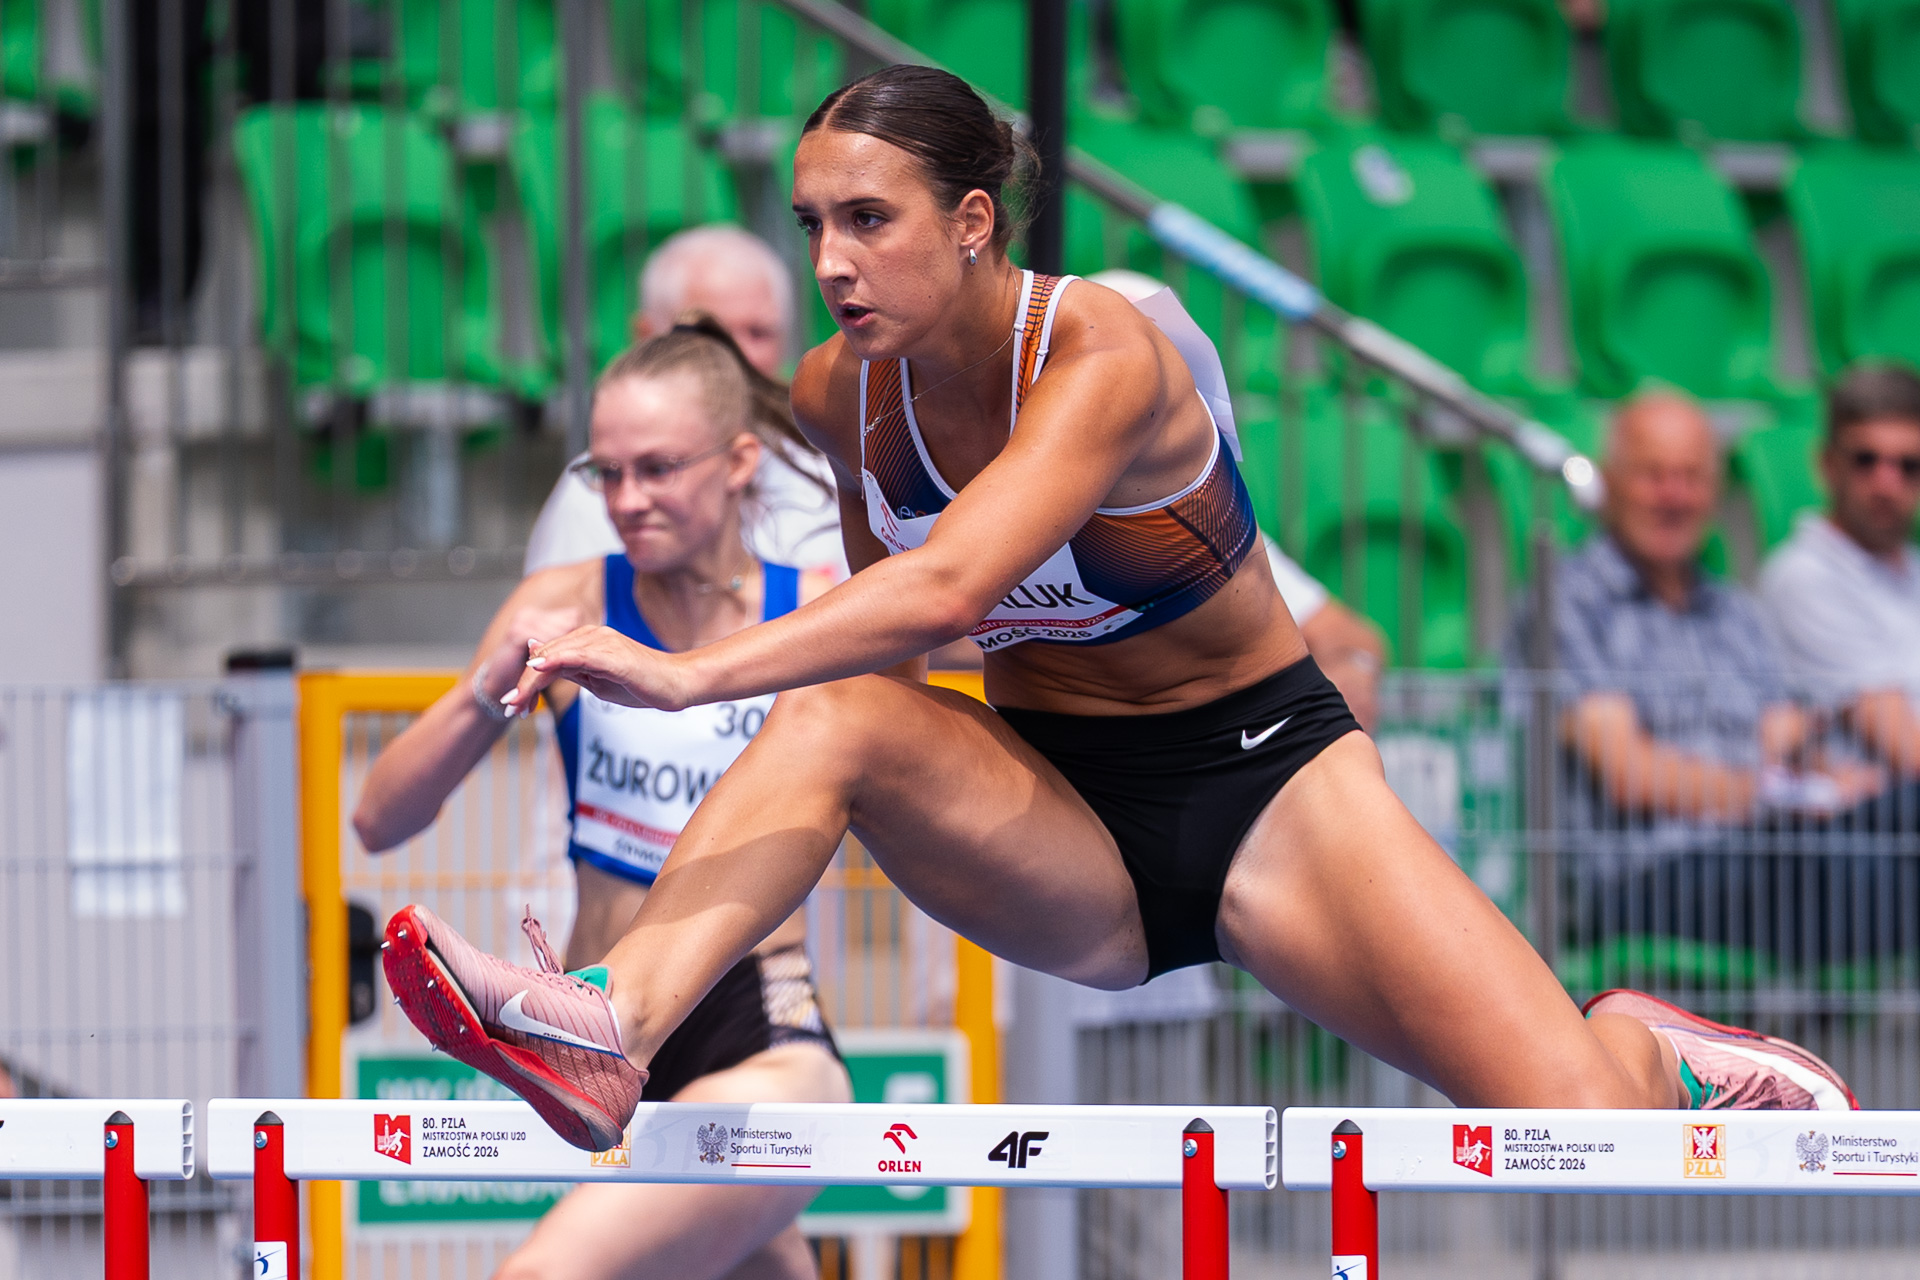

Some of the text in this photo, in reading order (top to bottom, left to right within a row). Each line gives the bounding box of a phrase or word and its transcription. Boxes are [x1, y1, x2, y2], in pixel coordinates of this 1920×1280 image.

[1080, 615, 1106, 627] U20
[1042, 628, 1093, 639] 2026
[422, 1117, 467, 1129] 80. PZLA
[422, 1131, 527, 1141] MISTRZOSTWA POLSKI U20
[730, 1127, 792, 1140] Ministerstwo
[1504, 1128, 1551, 1141] 80. PZLA
[1832, 1135, 1898, 1147] Ministerstwo
[422, 1142, 499, 1158] ZAMOŚĆ 2026
[730, 1142, 762, 1156] Sportu
[769, 1143, 812, 1157] Turystyki
[987, 1131, 1050, 1169] 4F
[1504, 1143, 1615, 1153] MISTRZOSTWA POLSKI U20
[592, 1150, 628, 1165] PZLA
[1504, 1154, 1586, 1171] ZAMOŚĆ 2026
[1832, 1150, 1865, 1164] Sportu
[1873, 1151, 1919, 1165] Turystyki
[877, 1160, 922, 1173] ORLEN
[1686, 1161, 1723, 1176] PZLA
